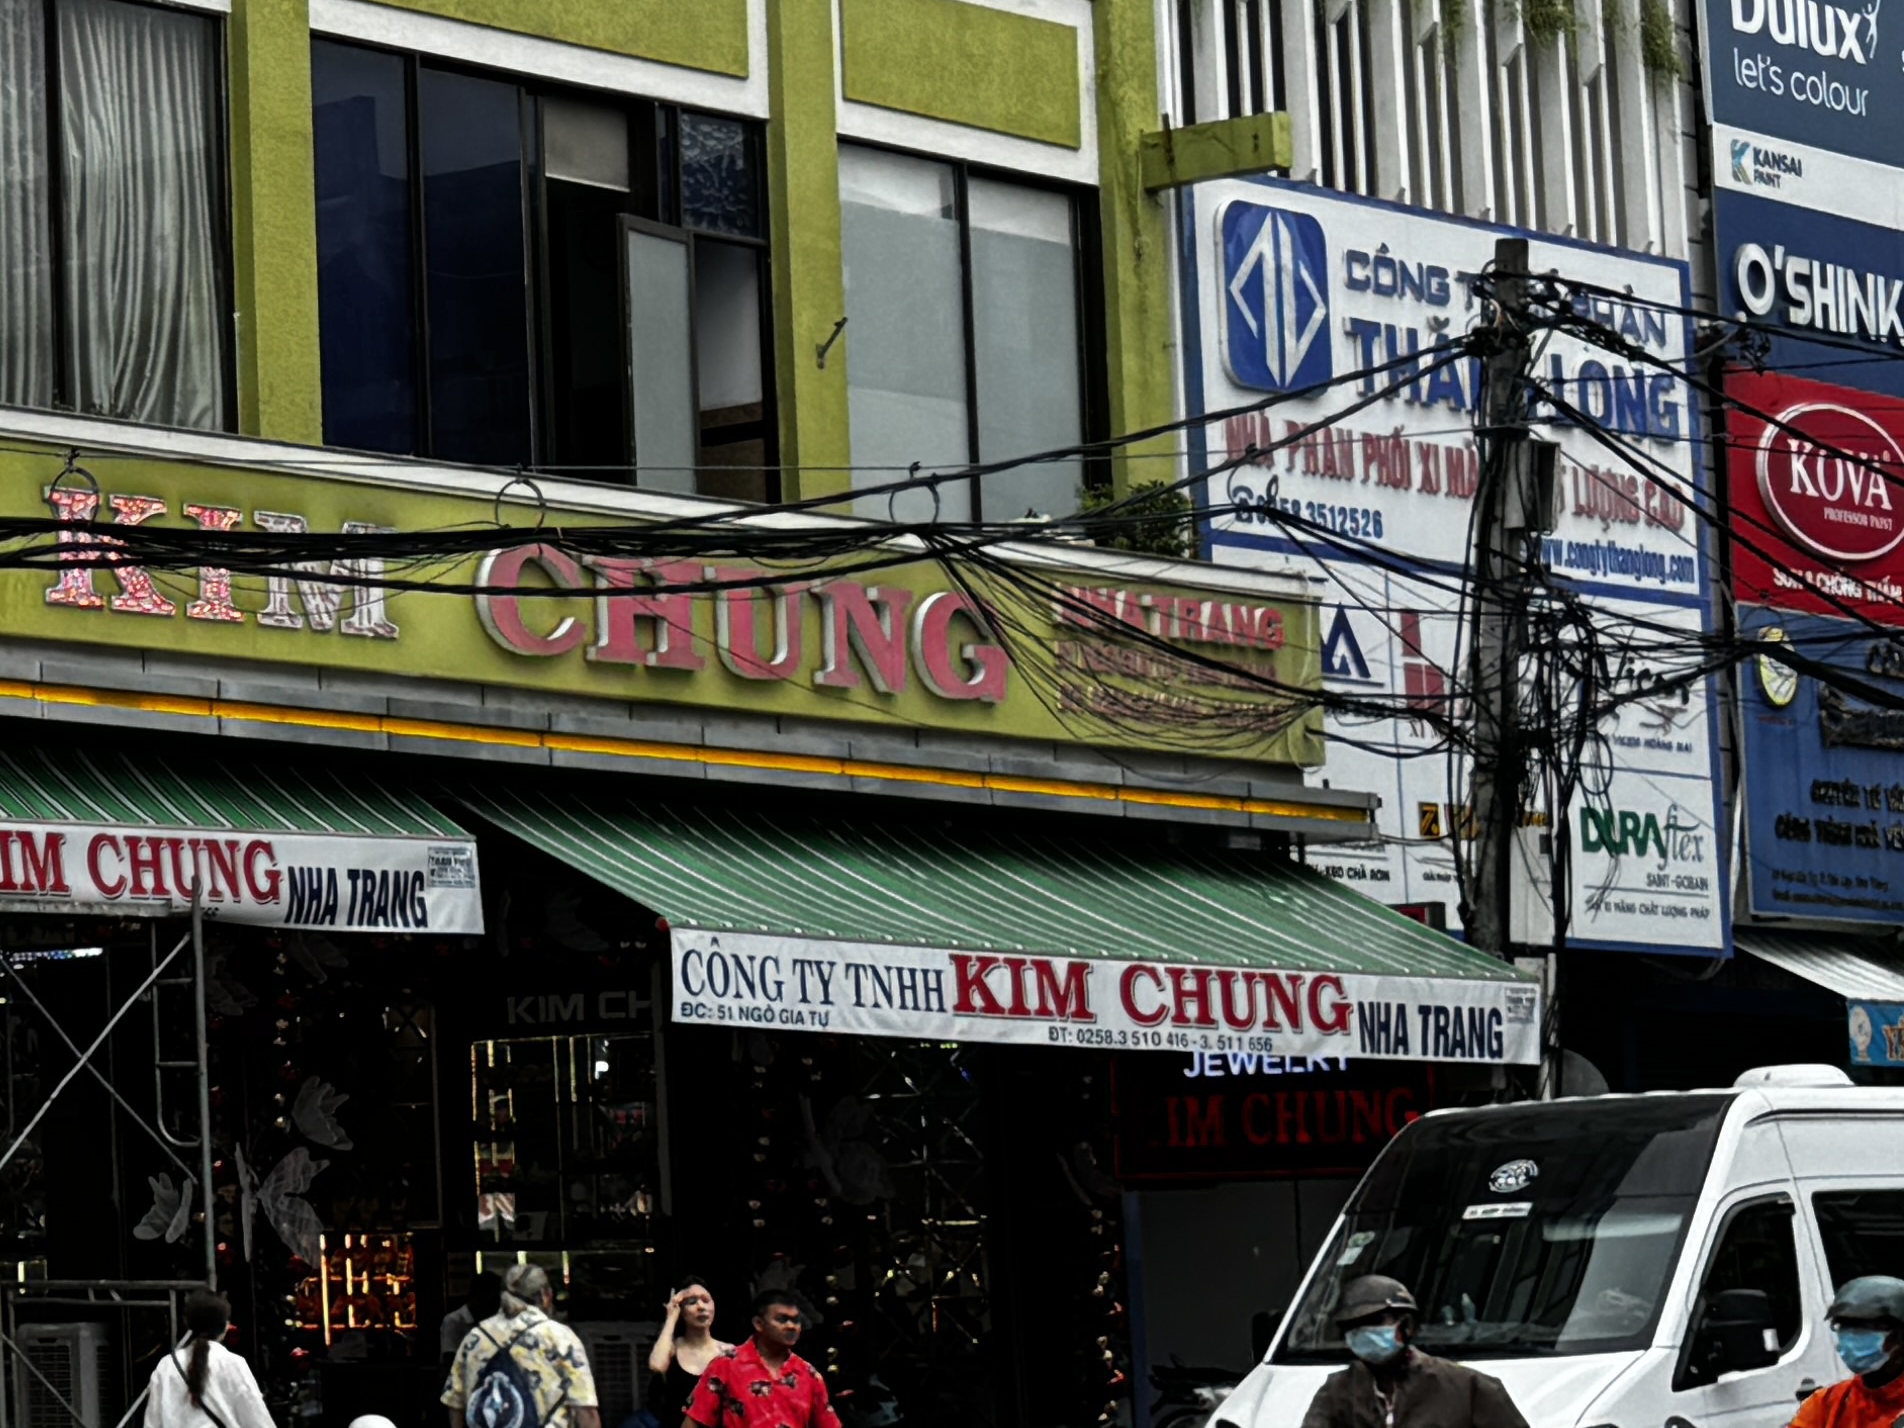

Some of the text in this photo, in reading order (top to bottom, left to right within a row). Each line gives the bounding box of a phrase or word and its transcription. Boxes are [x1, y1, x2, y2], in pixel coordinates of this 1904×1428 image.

[1734, 47, 1869, 117] let's colour
[1753, 147, 1802, 177] KANSAI
[1344, 243, 1450, 306] CÔNG
[1548, 353, 1682, 440] LONG
[1362, 424, 1411, 491] PHỐI
[1418, 442, 1440, 495] XI
[1645, 475, 1685, 532] CAO
[1787, 438, 1893, 512] KOVA
[43, 486, 1007, 703] KIM CHUNG
[1141, 594, 1285, 651] TRANG
[87, 832, 282, 906] CHUNG
[284, 865, 339, 926] NHA
[345, 869, 428, 929] TRANG
[681, 936, 785, 1003] CÔNG
[792, 958, 837, 1006] TY
[845, 963, 947, 1013] TNHH
[949, 953, 1097, 1023] KIM
[1119, 964, 1354, 1035] CHUNG
[1358, 1001, 1410, 1055] NHA
[1417, 1005, 1504, 1060] TRANG
[681, 1002, 712, 1019] ĐC:
[717, 1004, 733, 1020] 51
[779, 1009, 805, 1026] GIA
[1048, 1027, 1074, 1044] ĐT:
[1131, 1030, 1162, 1047] 510
[1167, 1033, 1189, 1048] 416
[1216, 1035, 1244, 1052] 511
[1247, 1036, 1274, 1053] 656
